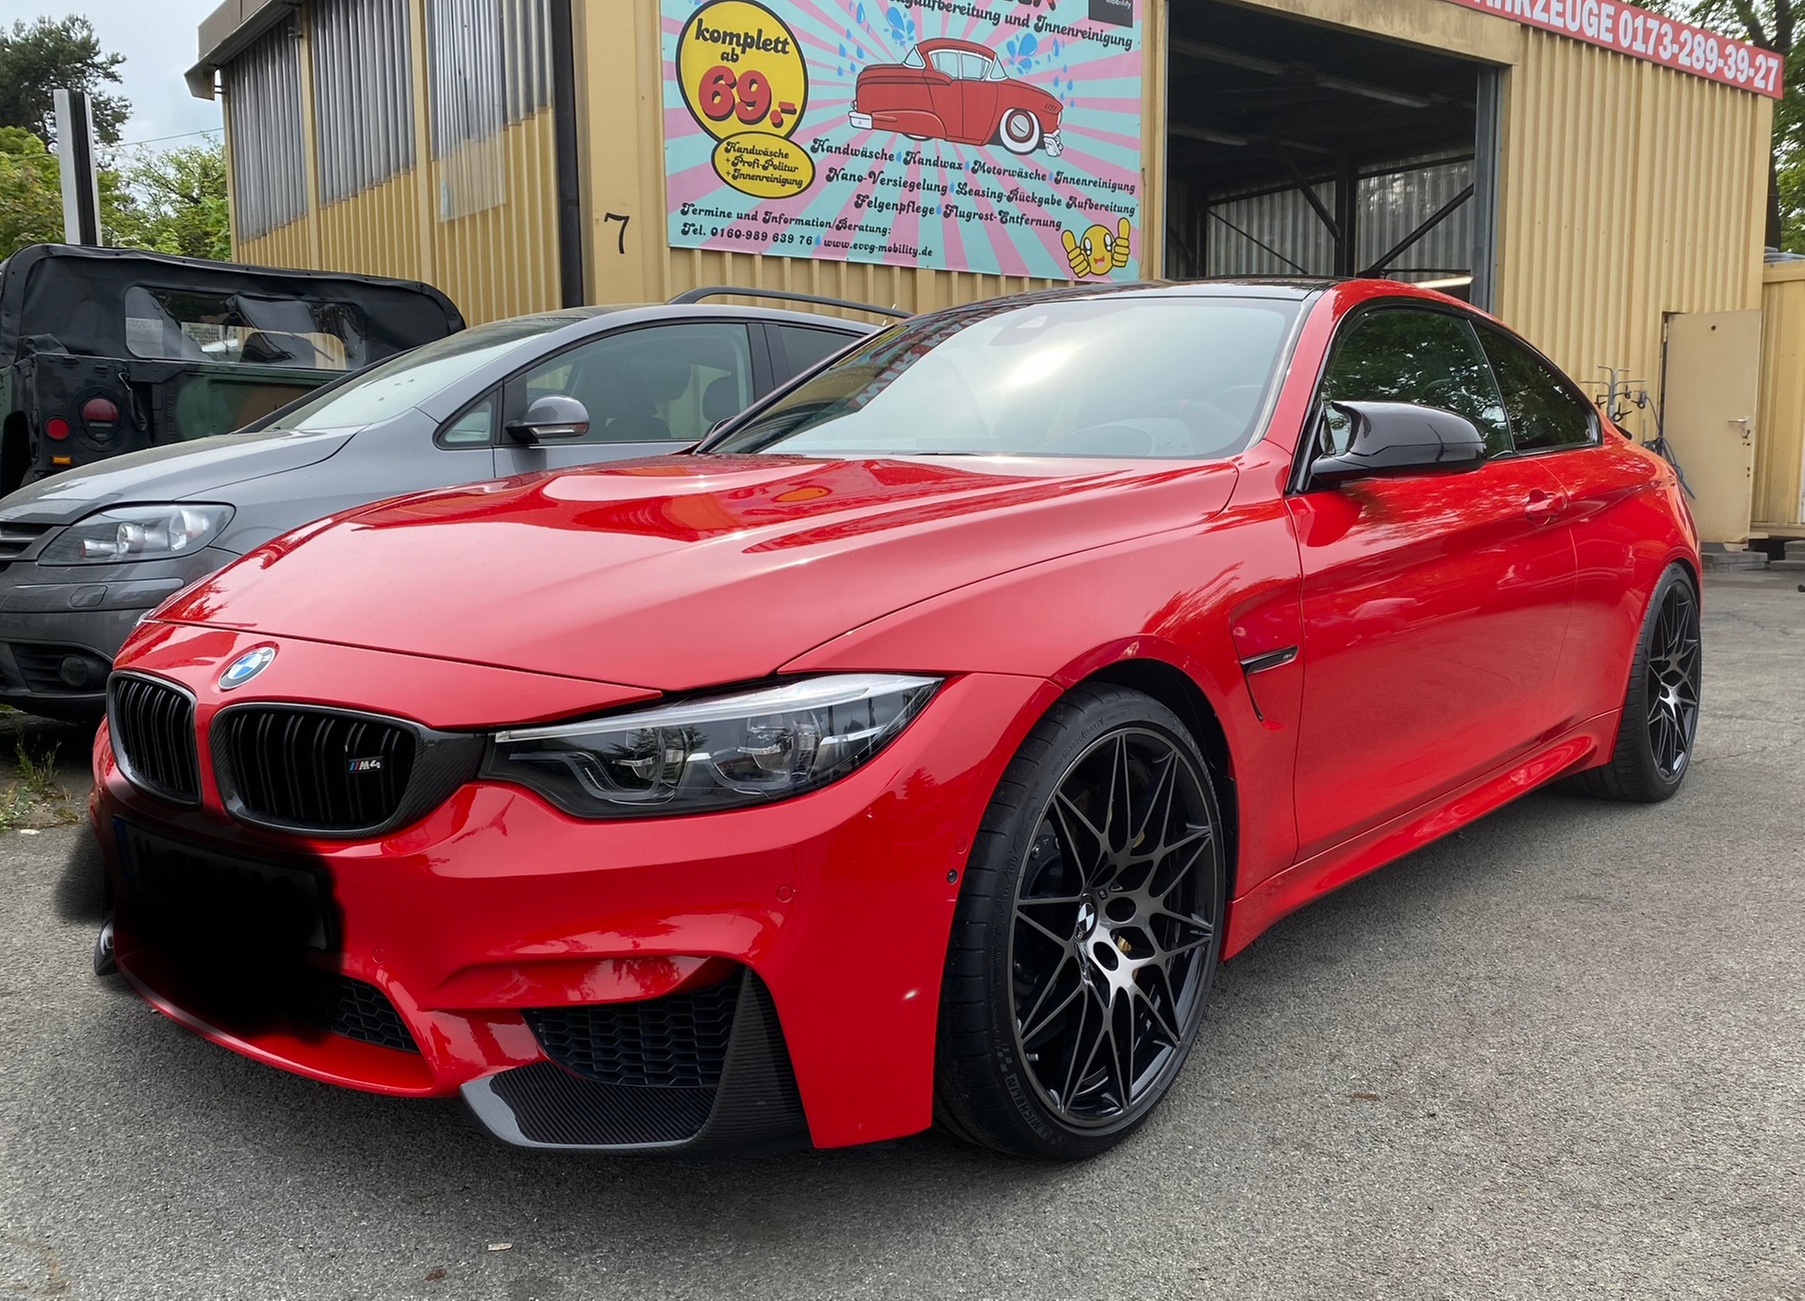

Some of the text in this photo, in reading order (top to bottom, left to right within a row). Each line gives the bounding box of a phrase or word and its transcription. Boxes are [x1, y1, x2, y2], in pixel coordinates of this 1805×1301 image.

[695, 18, 790, 54] komplett
[1004, 14, 1031, 28] und
[1034, 14, 1133, 51] Innenreinigung
[1474, 0, 1779, 92] ZEUGE 0173-289-39-27
[720, 47, 740, 62] ab
[724, 141, 789, 159] Handwäsche
[810, 138, 1136, 194] Handwäsche Handwax Motorwäsche Innenreinigung
[826, 167, 1136, 217] Nano-Versiegelung Leasing-Rückgabe Aufbereitung
[854, 193, 935, 217] Felgenpflege
[603, 212, 630, 254] 7
[680, 202, 891, 236] Termine und Information/Beratung:
[681, 222, 706, 236] Tel.
[710, 227, 768, 241] 0160-989
[772, 232, 794, 244] 639
[799, 235, 813, 245] 76
[358, 759, 381, 771] M4
[1007, 1076, 1043, 1131] MICHELIN
